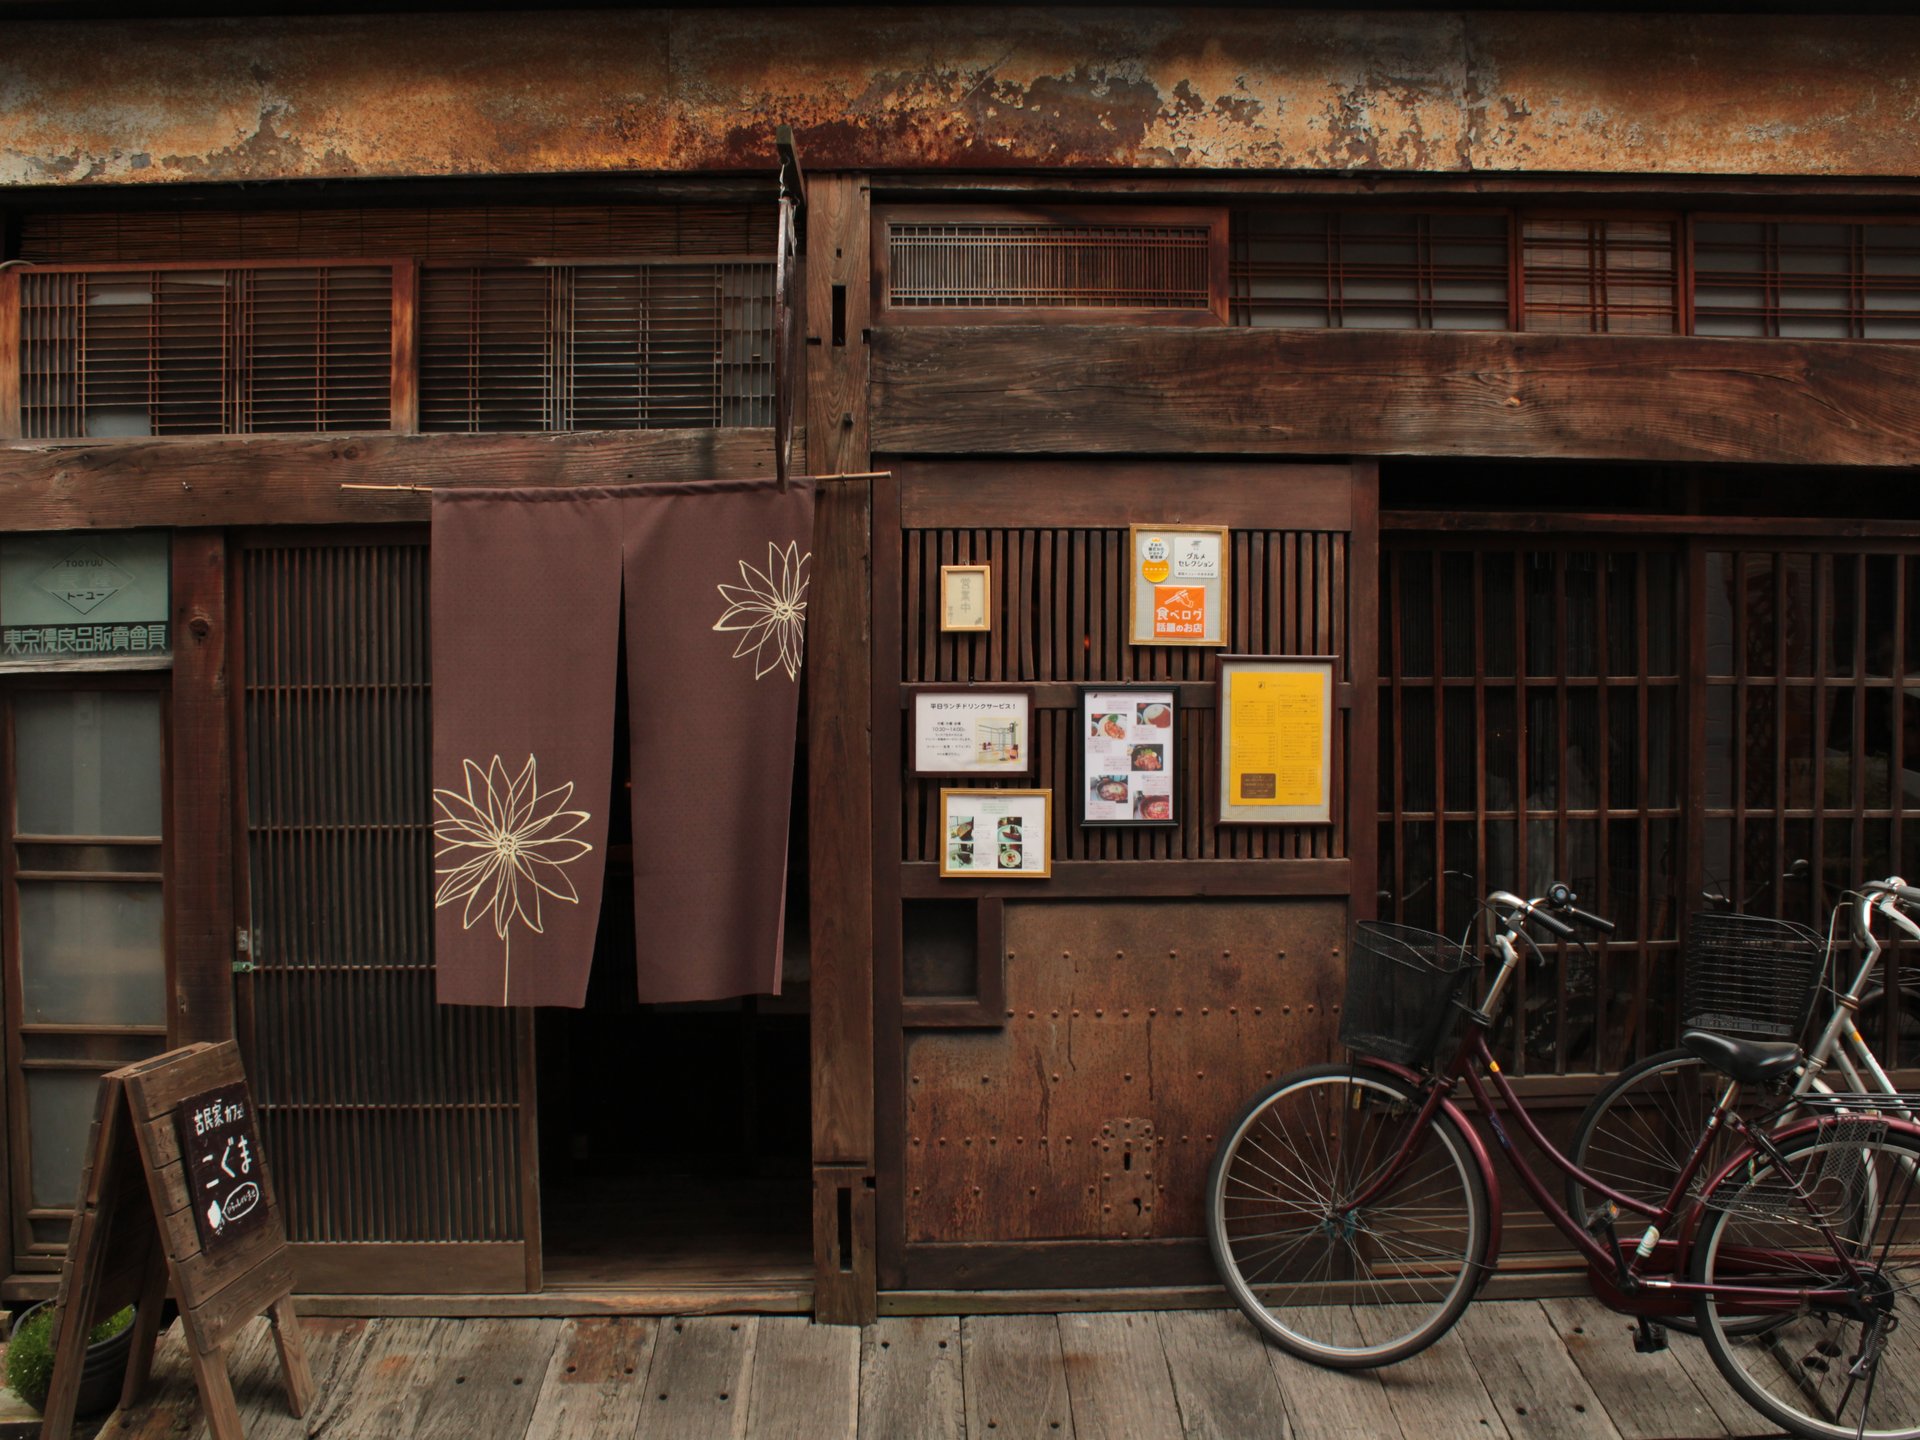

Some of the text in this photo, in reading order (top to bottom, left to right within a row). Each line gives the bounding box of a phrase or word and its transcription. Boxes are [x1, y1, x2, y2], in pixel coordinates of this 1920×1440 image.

[1186, 552, 1205, 560] グルメ
[65, 559, 103, 567] TOOYUU
[67, 591, 105, 600] トーユー
[1156, 606, 1203, 620] 食べログ
[202, 1135, 252, 1189] こぐま
